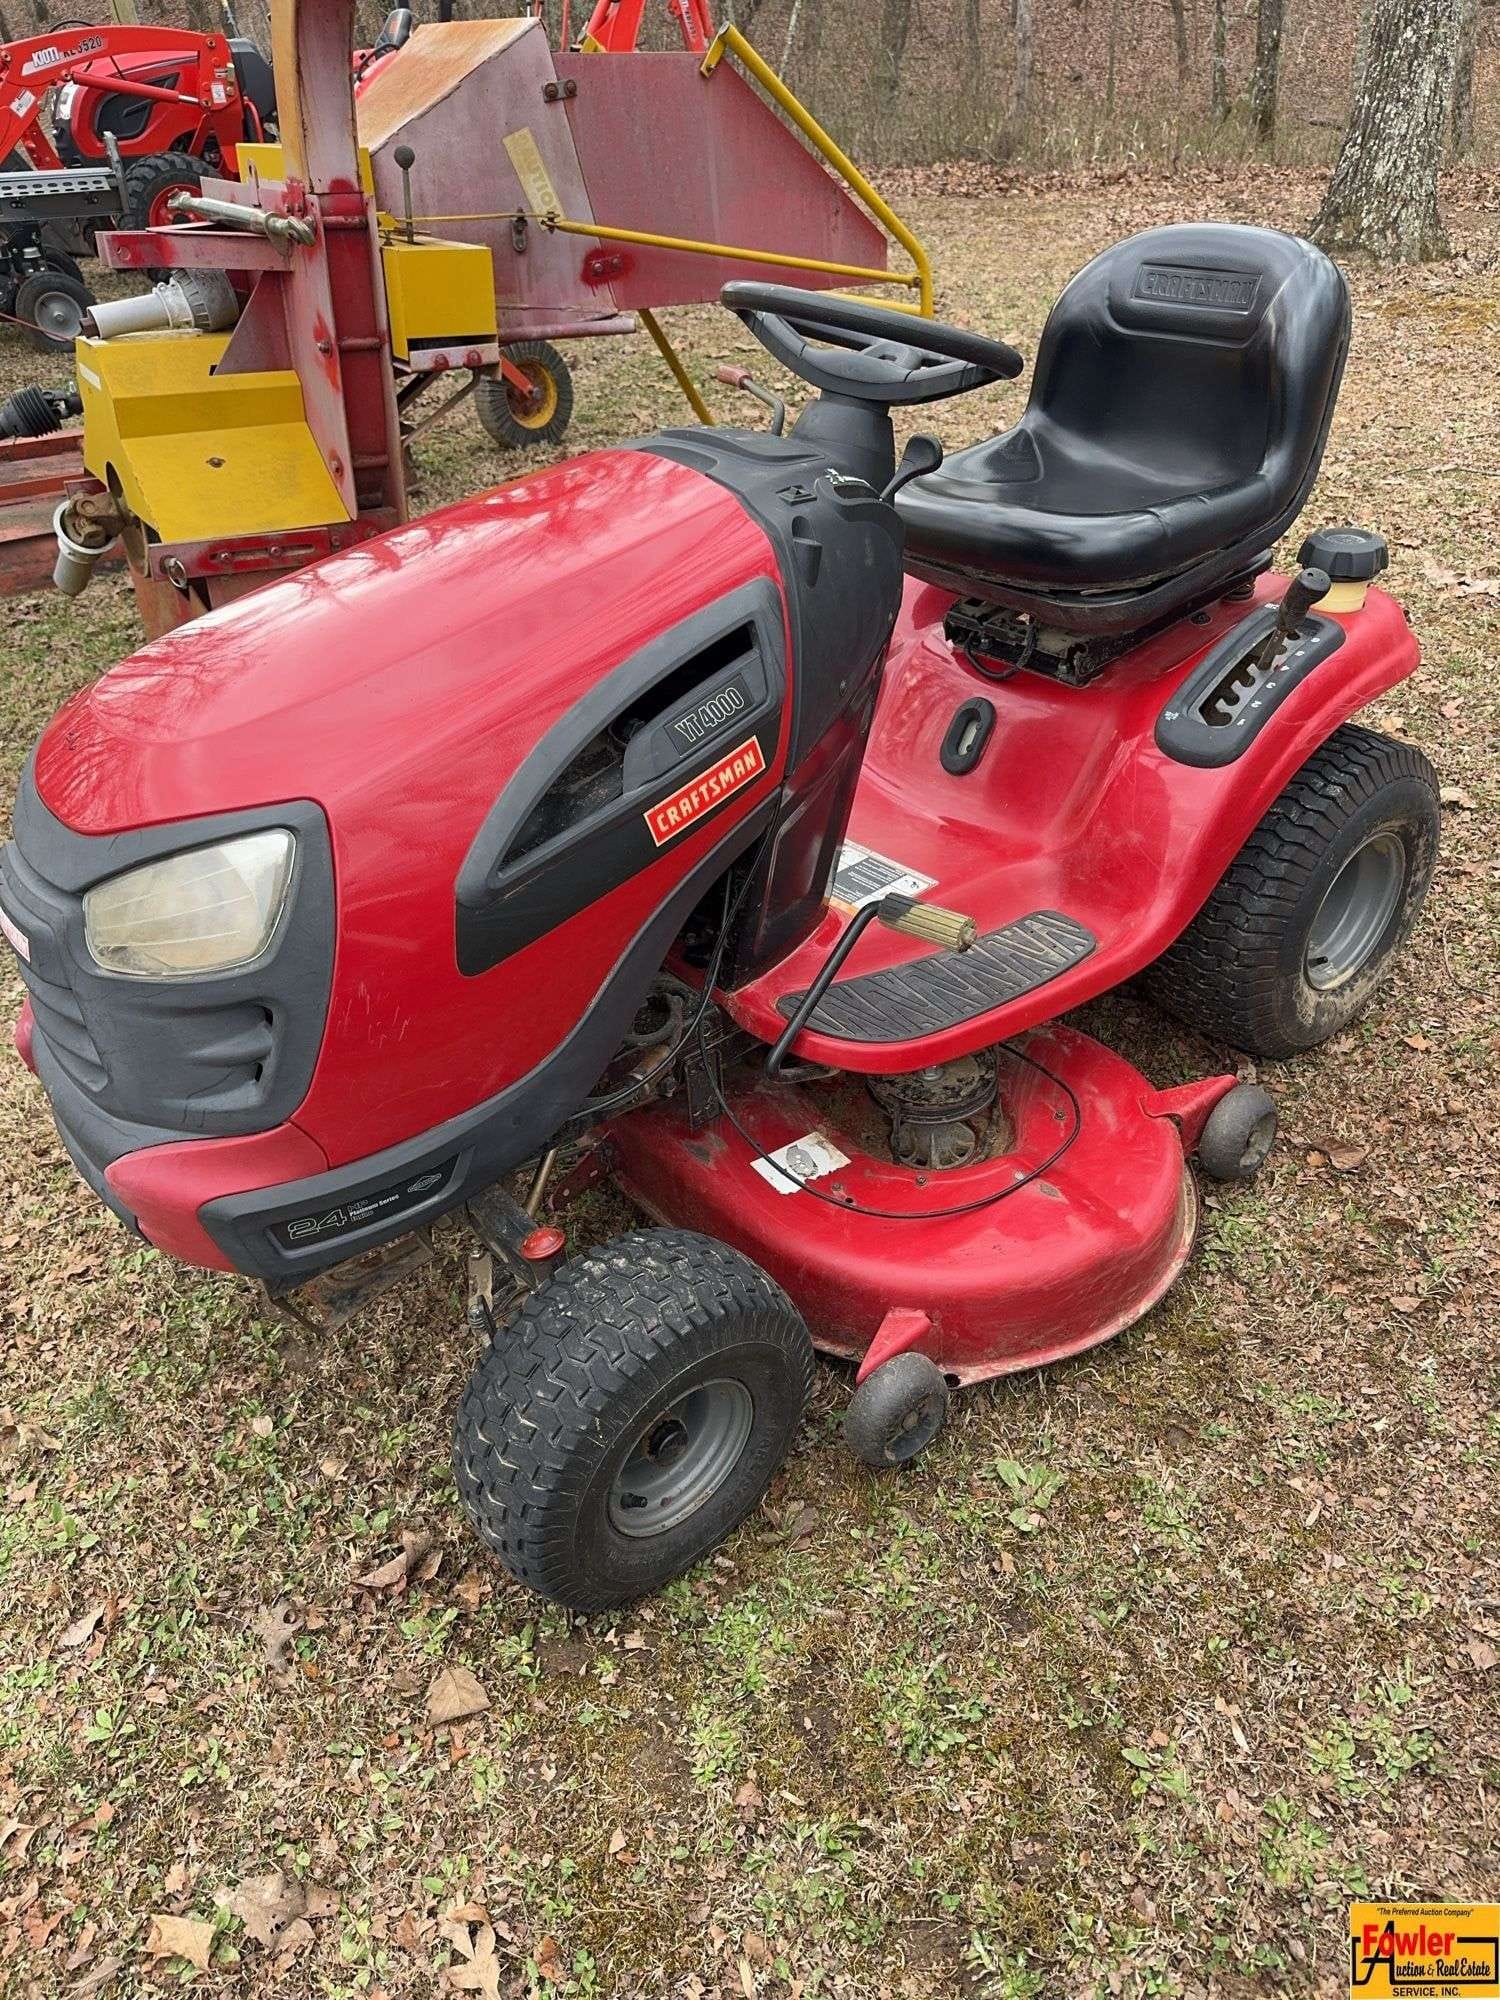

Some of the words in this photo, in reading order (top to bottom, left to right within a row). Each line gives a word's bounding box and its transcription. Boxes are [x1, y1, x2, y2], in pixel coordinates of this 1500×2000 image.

[1141, 273, 1252, 304] CRAFTSMAN
[674, 713, 705, 743] YT
[697, 687, 745, 728] 4000
[655, 750, 757, 833] CRAFTSMAN
[378, 1194, 400, 1206] Series
[287, 1208, 348, 1240] 24
